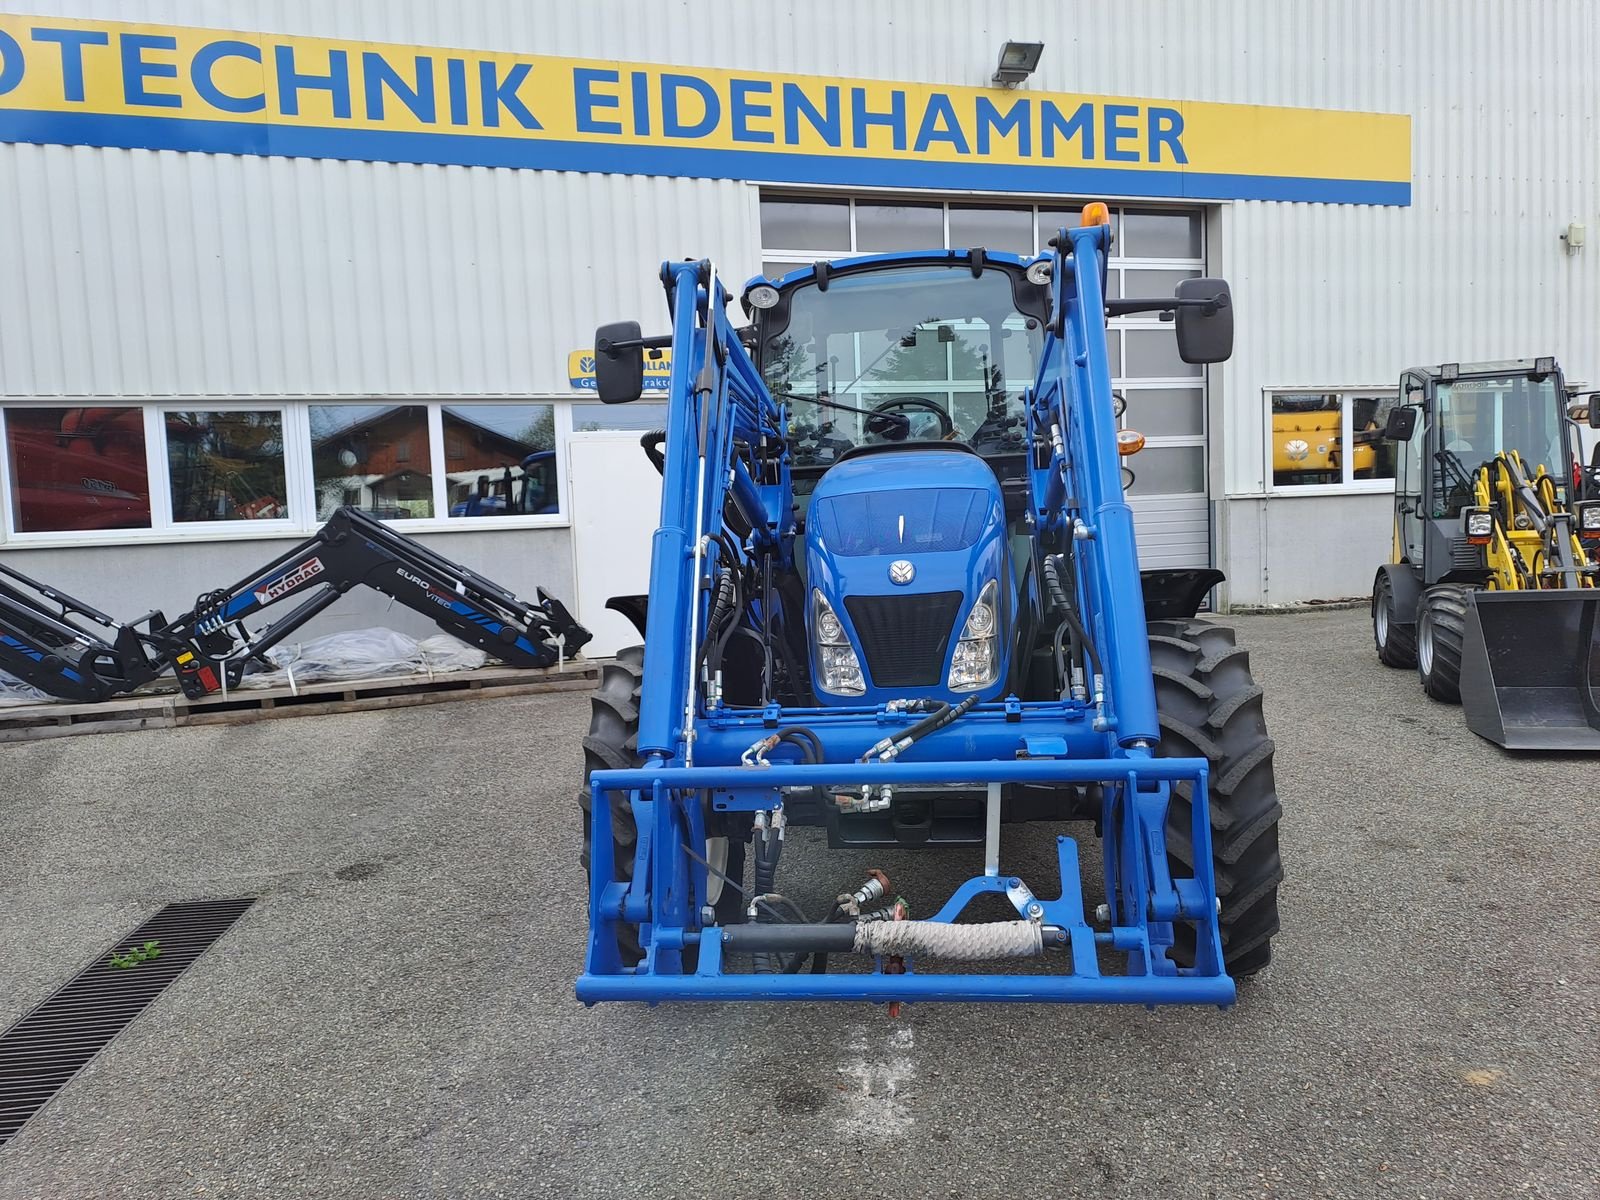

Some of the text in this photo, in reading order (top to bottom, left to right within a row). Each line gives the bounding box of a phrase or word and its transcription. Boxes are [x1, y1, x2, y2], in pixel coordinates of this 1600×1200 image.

[572, 67, 1189, 165] EIDENHAMMER
[268, 564, 321, 598] HYDRAC
[396, 567, 430, 590] EURO
